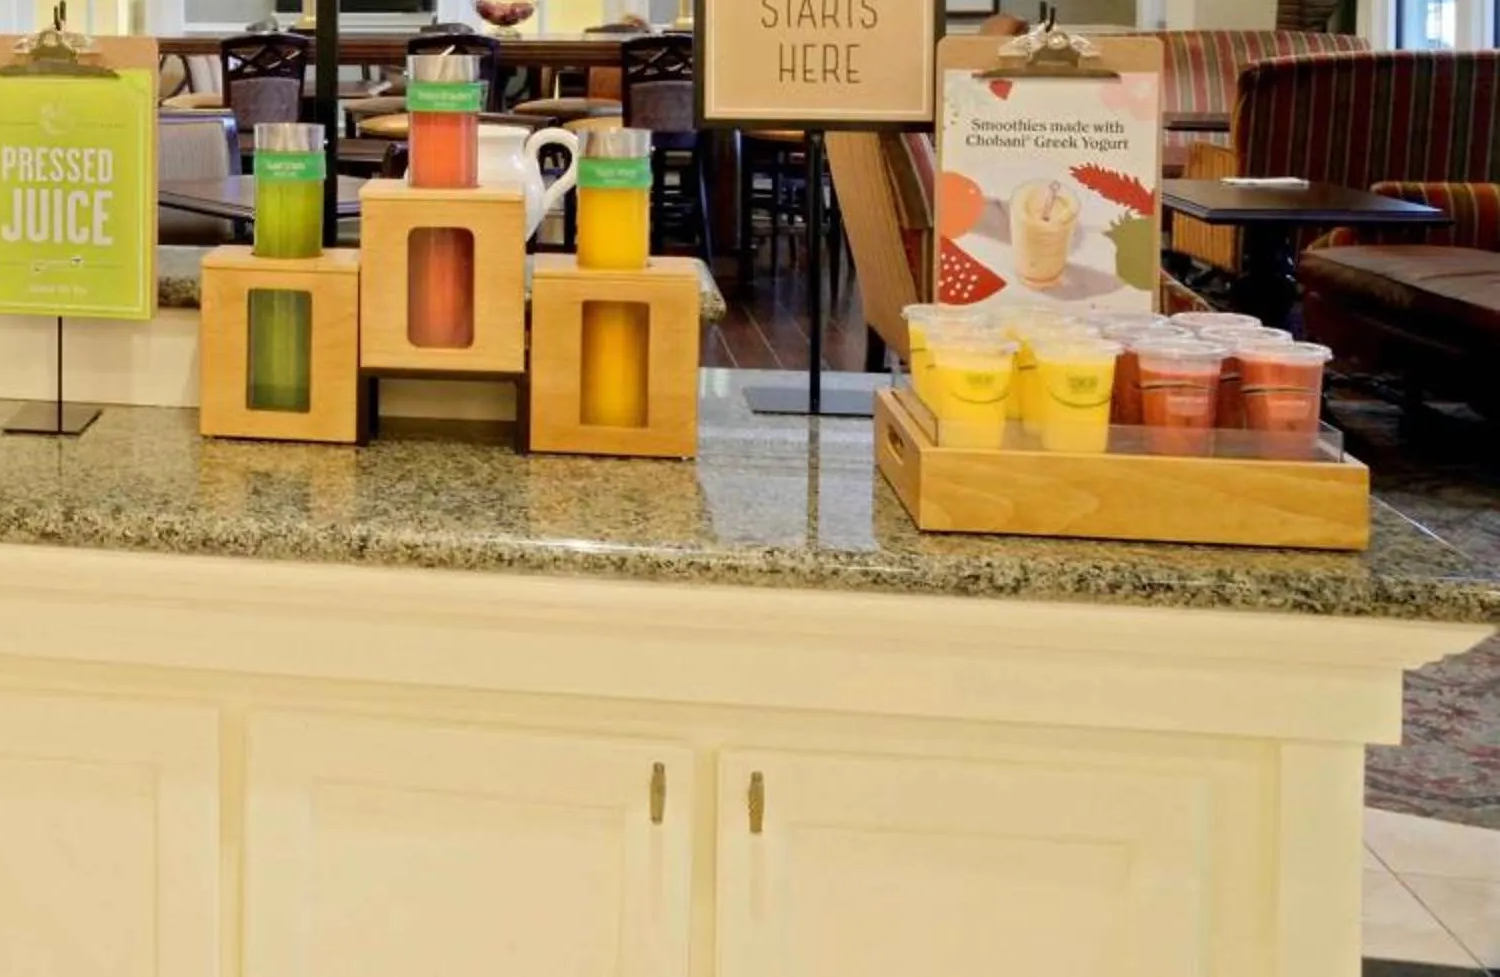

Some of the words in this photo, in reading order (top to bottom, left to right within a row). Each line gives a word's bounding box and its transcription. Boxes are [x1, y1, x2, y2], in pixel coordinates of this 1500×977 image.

[778, 42, 862, 84] HERE
[971, 118, 1047, 132] Smoothies
[1051, 121, 1090, 133] made
[1093, 121, 1124, 134] with
[1034, 135, 1078, 149] Greek
[1081, 136, 1130, 152] Yogurt
[1, 146, 114, 183] PRESSED
[1, 187, 115, 246] JUICE
